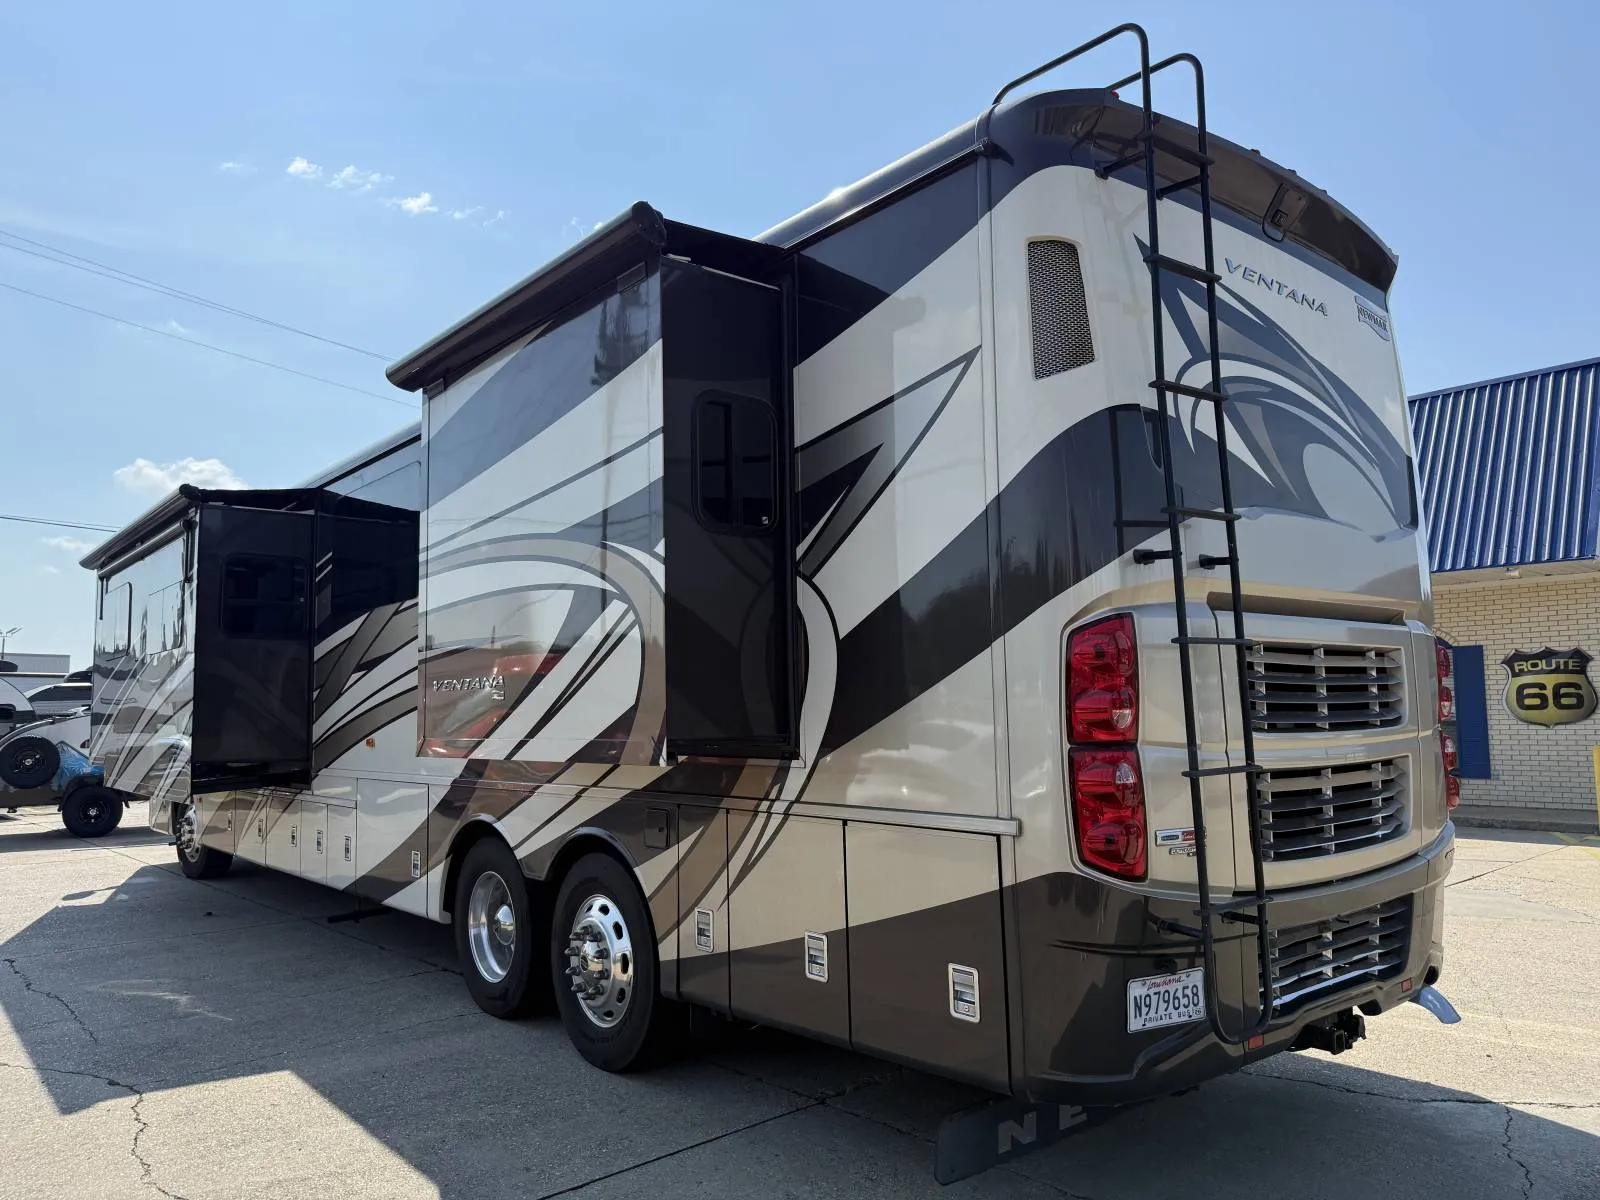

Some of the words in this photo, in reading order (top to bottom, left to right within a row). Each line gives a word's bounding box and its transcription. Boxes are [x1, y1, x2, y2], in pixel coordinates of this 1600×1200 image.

[1225, 256, 1328, 317] VENTANA
[1514, 658, 1580, 673] ROUTE
[432, 675, 505, 693] VENTANA
[1515, 682, 1585, 711] 66
[1133, 984, 1200, 1019] N979658
[1143, 1012, 1173, 1024] PRIVATE
[1177, 1009, 1191, 1019] BUS
